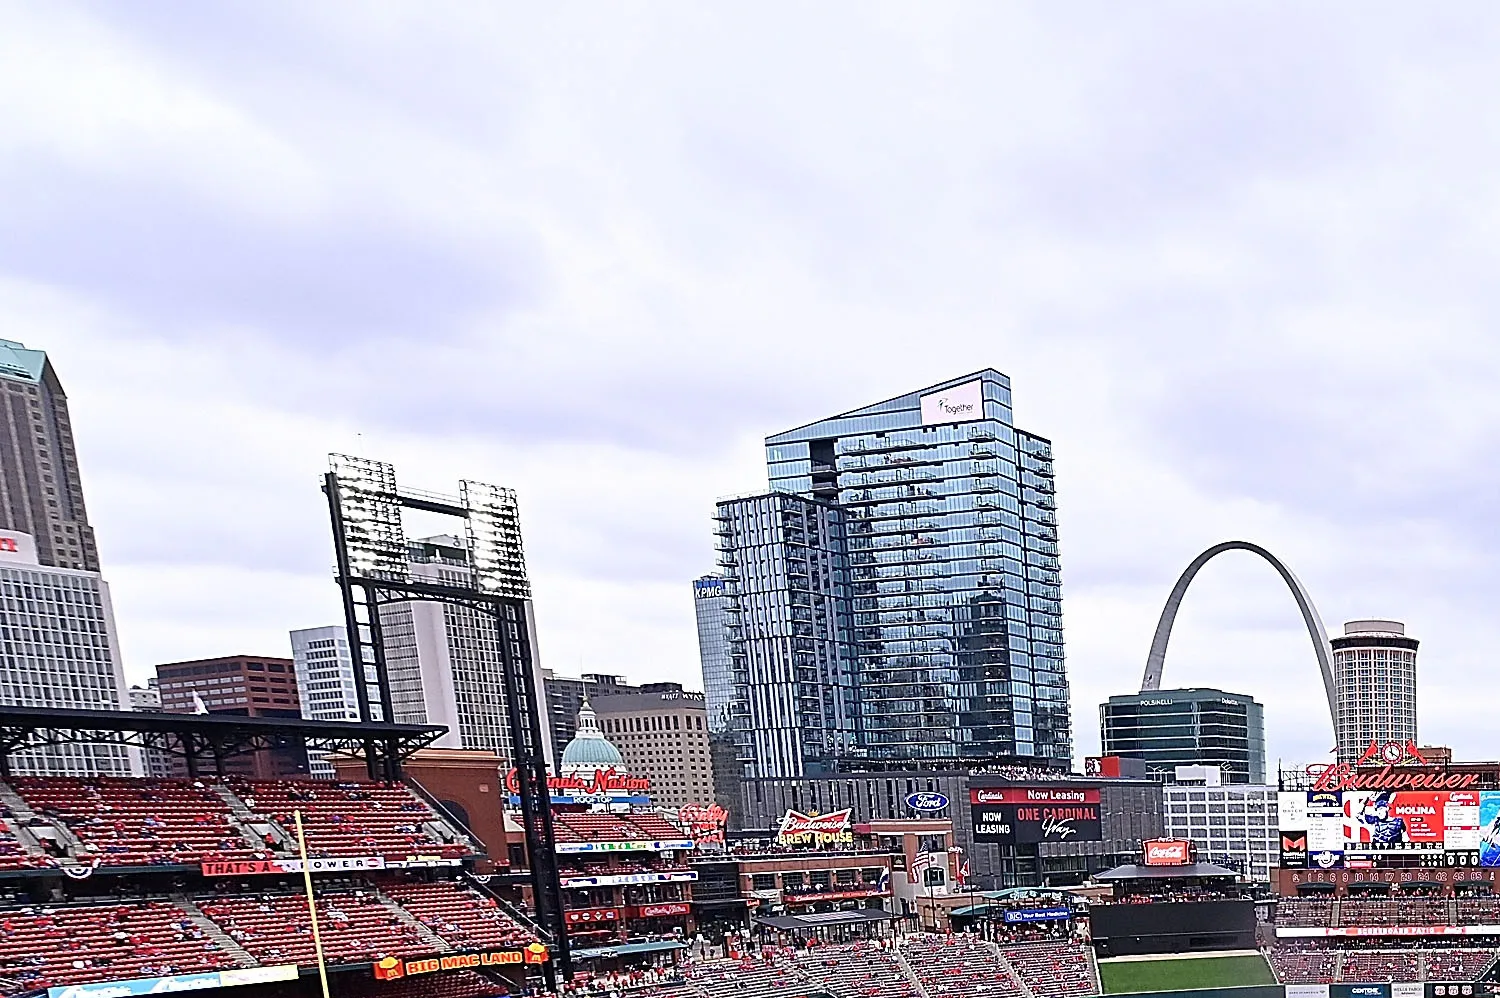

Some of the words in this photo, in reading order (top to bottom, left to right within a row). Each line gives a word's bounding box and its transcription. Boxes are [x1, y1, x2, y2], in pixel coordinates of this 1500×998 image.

[944, 404, 973, 415] Together
[505, 767, 587, 794] Cinals
[588, 767, 650, 794] Nation
[1306, 763, 1479, 791] Budweiser
[573, 796, 613, 804] ROOFTOP
[916, 794, 941, 807] Ford
[978, 790, 1003, 802] Cardinals
[1027, 790, 1048, 800] Now
[1050, 790, 1085, 802] Leasing
[1017, 808, 1040, 820] ONE
[1043, 808, 1097, 820] CARDINAL
[1396, 807, 1436, 815] MOLINA
[982, 812, 1002, 822] NOW
[777, 815, 851, 832] Budweiser
[975, 824, 1011, 834] LEASING
[1041, 815, 1076, 839] Way
[779, 833, 811, 844] BREW
[814, 831, 853, 843] HOUSE
[206, 862, 256, 875] THAT'S
[262, 861, 270, 872] A
[300, 859, 364, 871] OWER
[1342, 873, 1348, 882] 9
[1370, 873, 1379, 882] 14
[1400, 872, 1412, 881] 20
[1417, 872, 1430, 881] 24
[1436, 872, 1447, 881] 42
[406, 959, 439, 975] BIG
[440, 955, 481, 970] MAC
[481, 952, 523, 966] LAND
